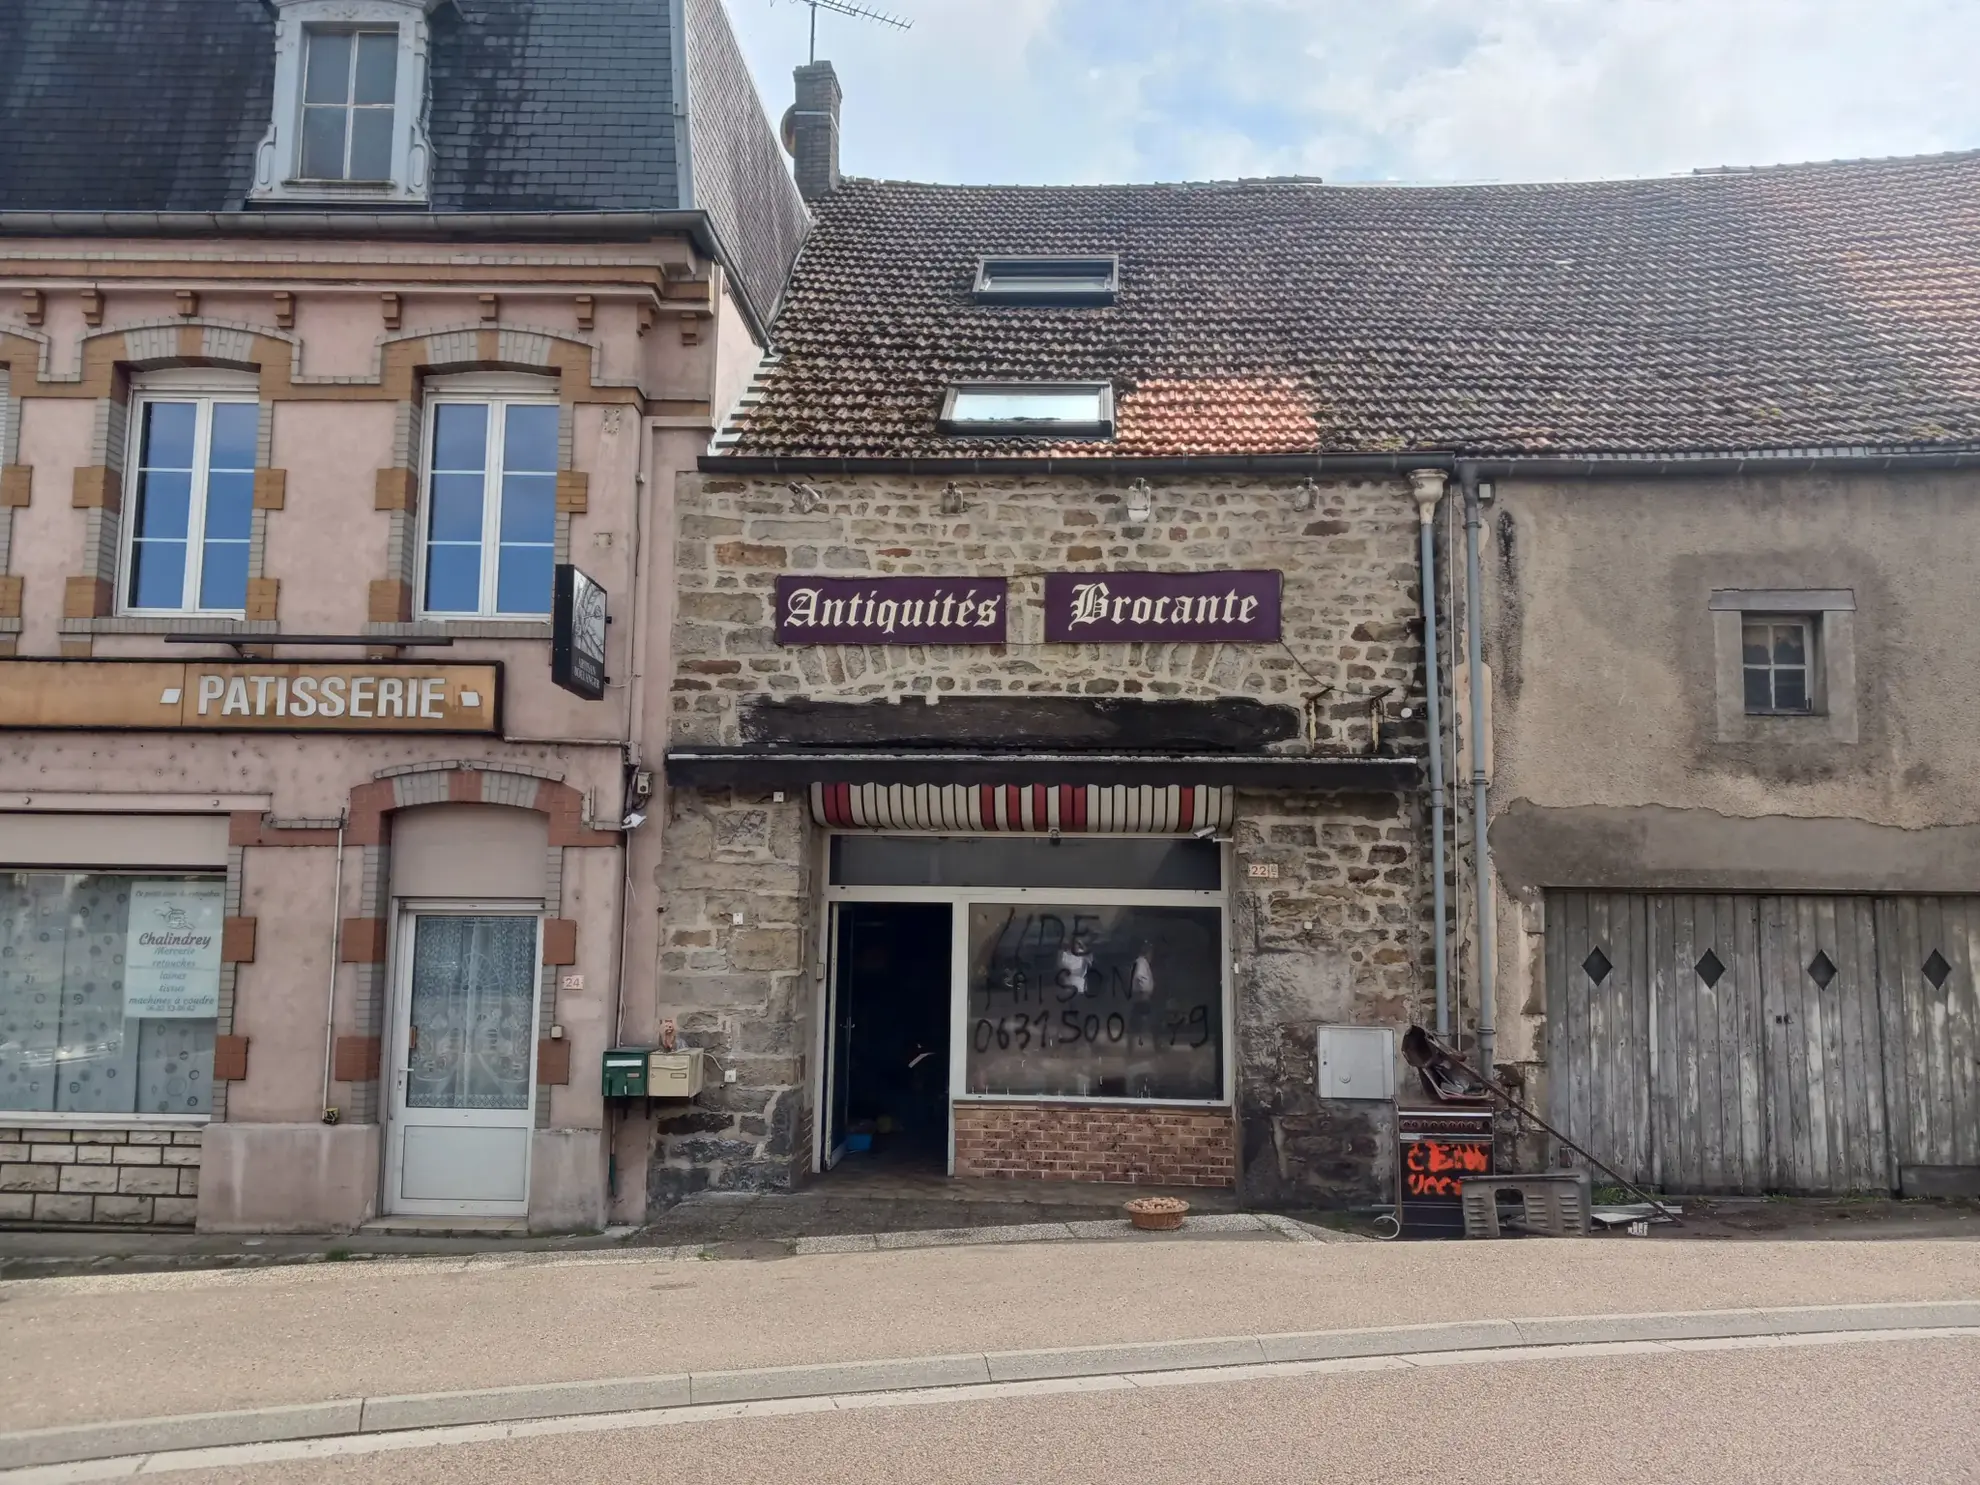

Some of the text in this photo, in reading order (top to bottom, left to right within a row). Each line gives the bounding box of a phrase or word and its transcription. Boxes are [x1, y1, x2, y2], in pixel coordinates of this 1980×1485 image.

[783, 581, 1259, 635] Antiquités Brocante
[197, 675, 446, 719] PATISSERIE
[1251, 865, 1267, 876] 22
[138, 931, 212, 949] Chalindrey
[154, 947, 196, 955] Mercerie
[152, 957, 196, 967] retouches
[159, 971, 187, 980] laines
[158, 984, 185, 992] tissus
[565, 977, 581, 988] 24
[128, 994, 172, 1005] machines
[183, 994, 215, 1005] coudre
